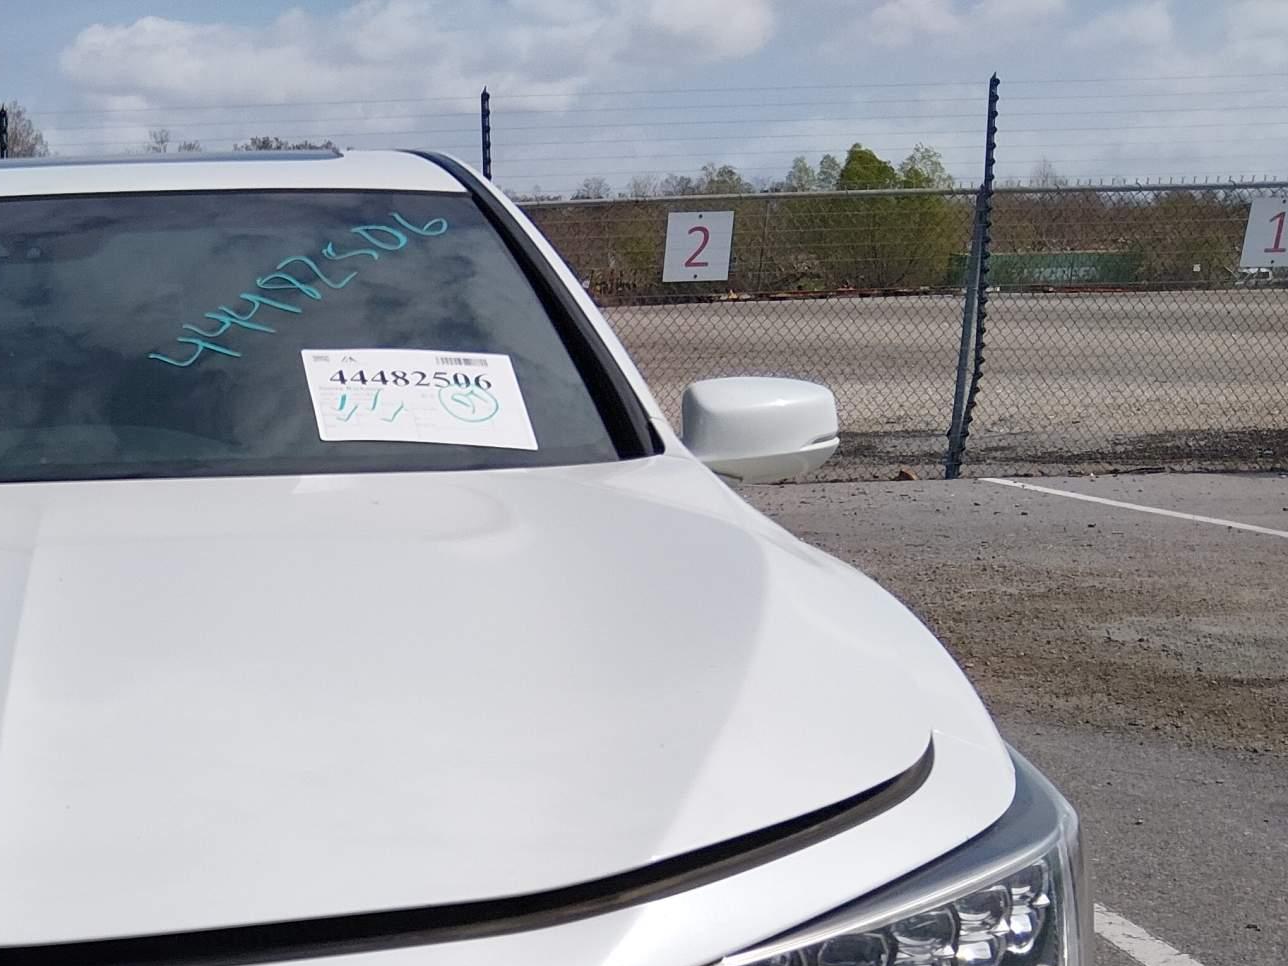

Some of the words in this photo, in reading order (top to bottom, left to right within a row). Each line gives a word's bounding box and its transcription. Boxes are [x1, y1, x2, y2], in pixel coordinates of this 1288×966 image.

[684, 225, 710, 268] 2
[1263, 211, 1287, 254] 1
[328, 368, 493, 391] 44482506
